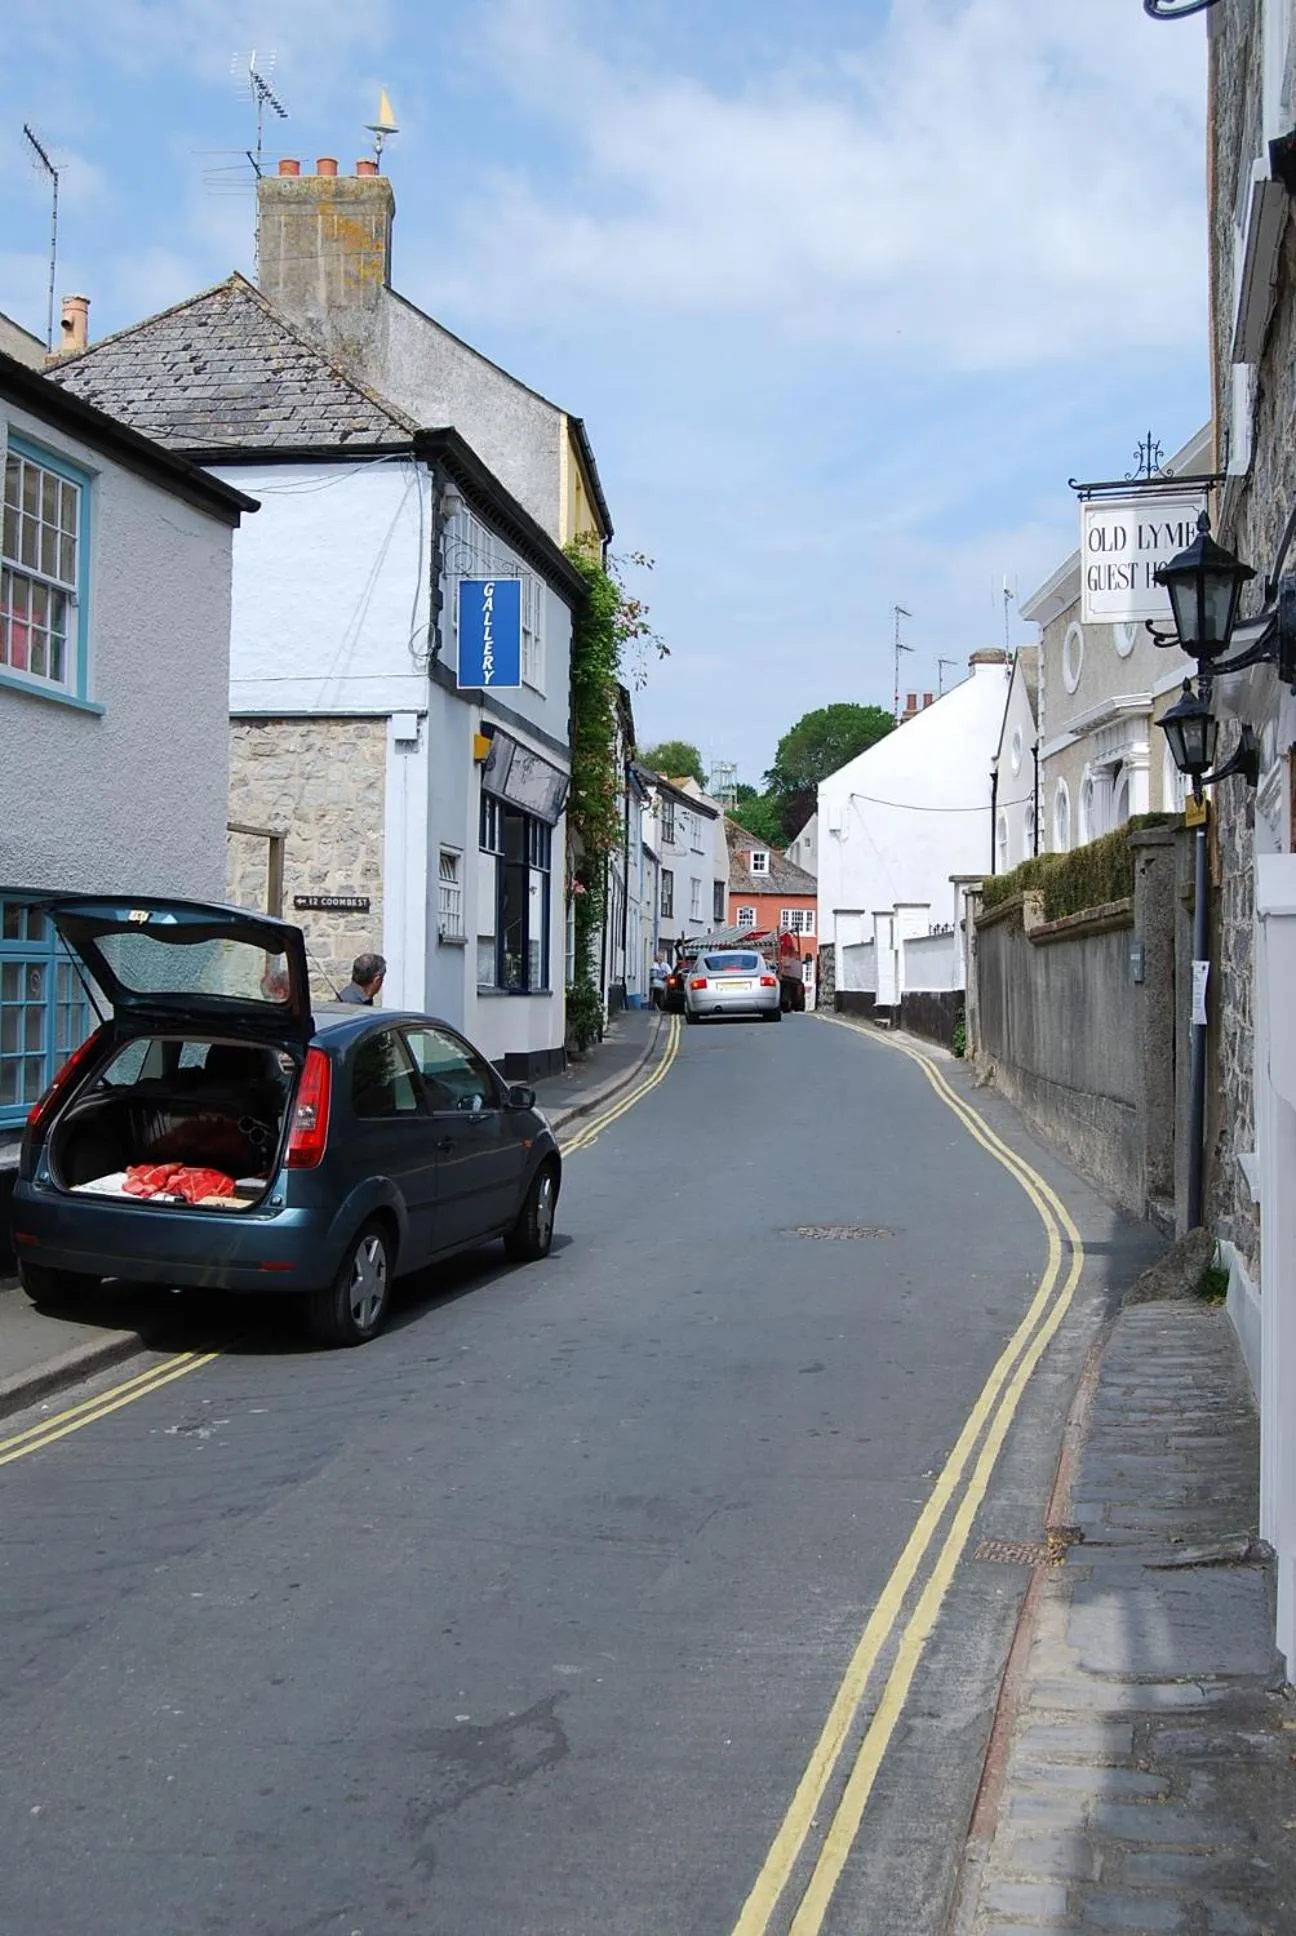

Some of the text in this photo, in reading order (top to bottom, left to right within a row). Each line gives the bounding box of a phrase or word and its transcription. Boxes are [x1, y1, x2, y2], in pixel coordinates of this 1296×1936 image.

[1088, 526, 1127, 553] OLD
[1087, 562, 1139, 591] GUEST
[482, 582, 496, 685] GALLERY
[309, 897, 319, 906] 12
